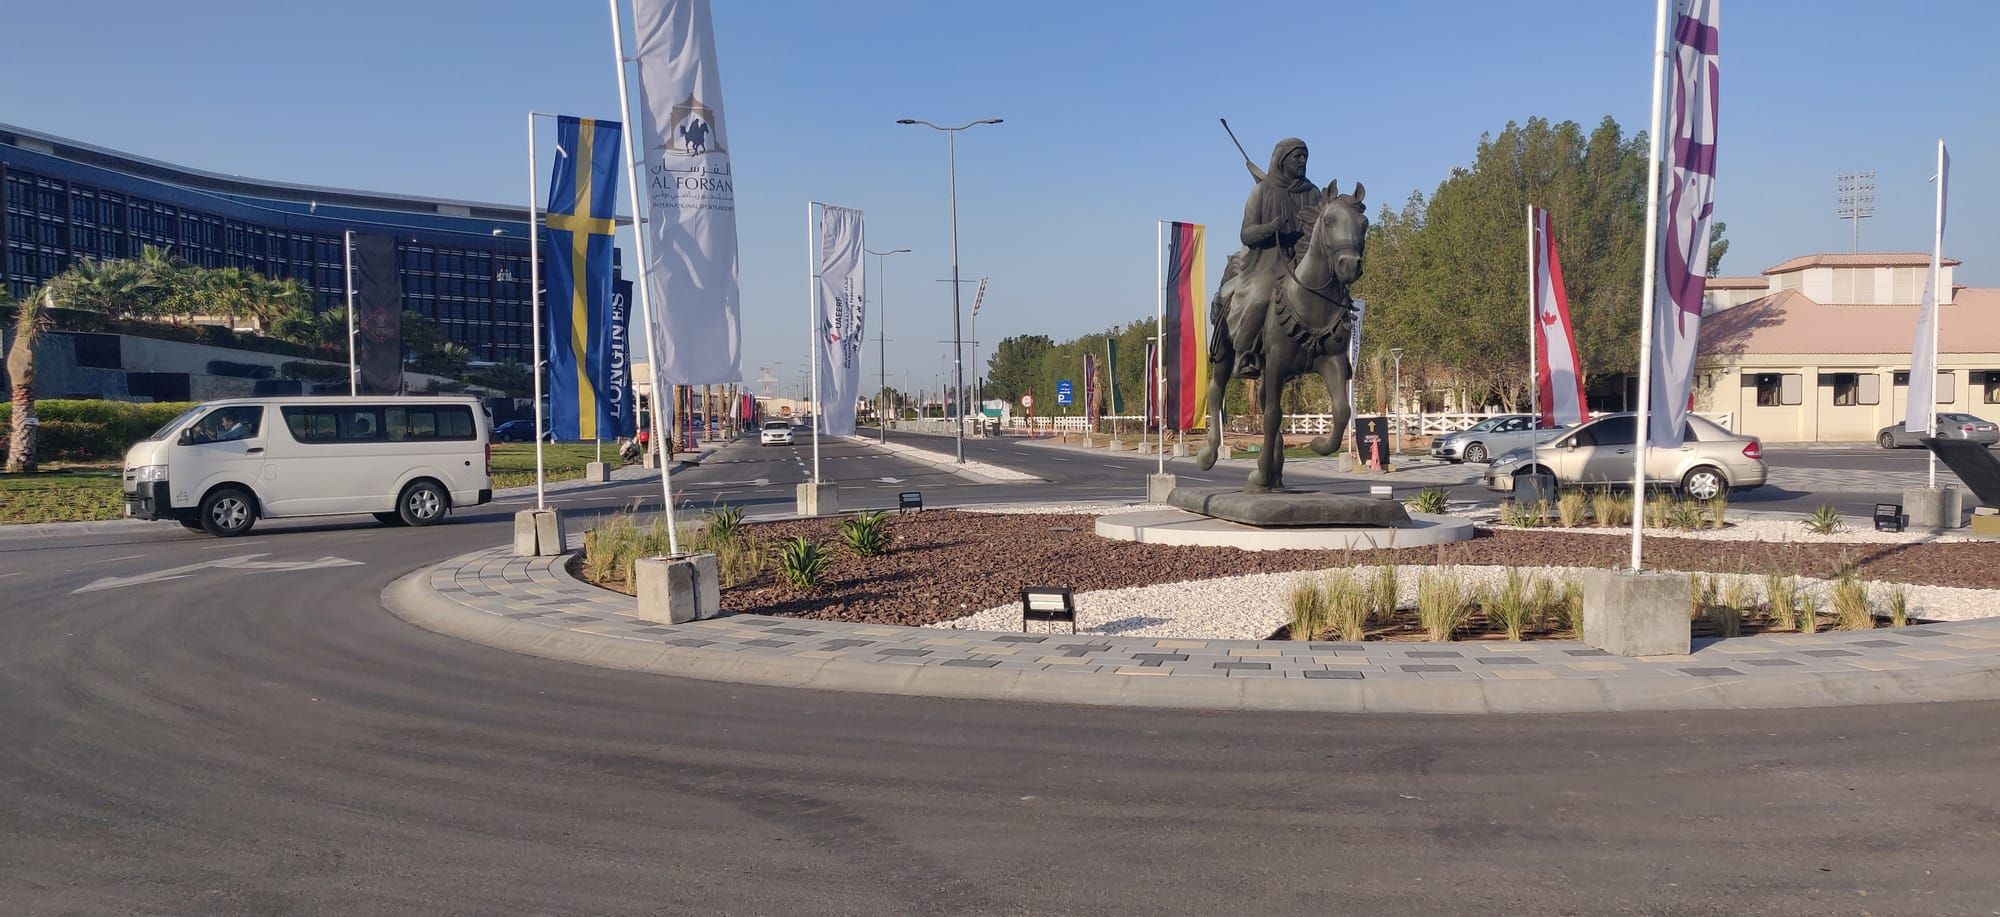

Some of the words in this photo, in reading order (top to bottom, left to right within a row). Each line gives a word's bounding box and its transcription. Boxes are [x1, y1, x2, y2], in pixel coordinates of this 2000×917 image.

[652, 176, 671, 189] AL
[676, 177, 733, 192] FORSAN
[835, 296, 843, 329] UAEERF
[610, 293, 624, 419] LONGINES
[1058, 394, 1065, 403] P
